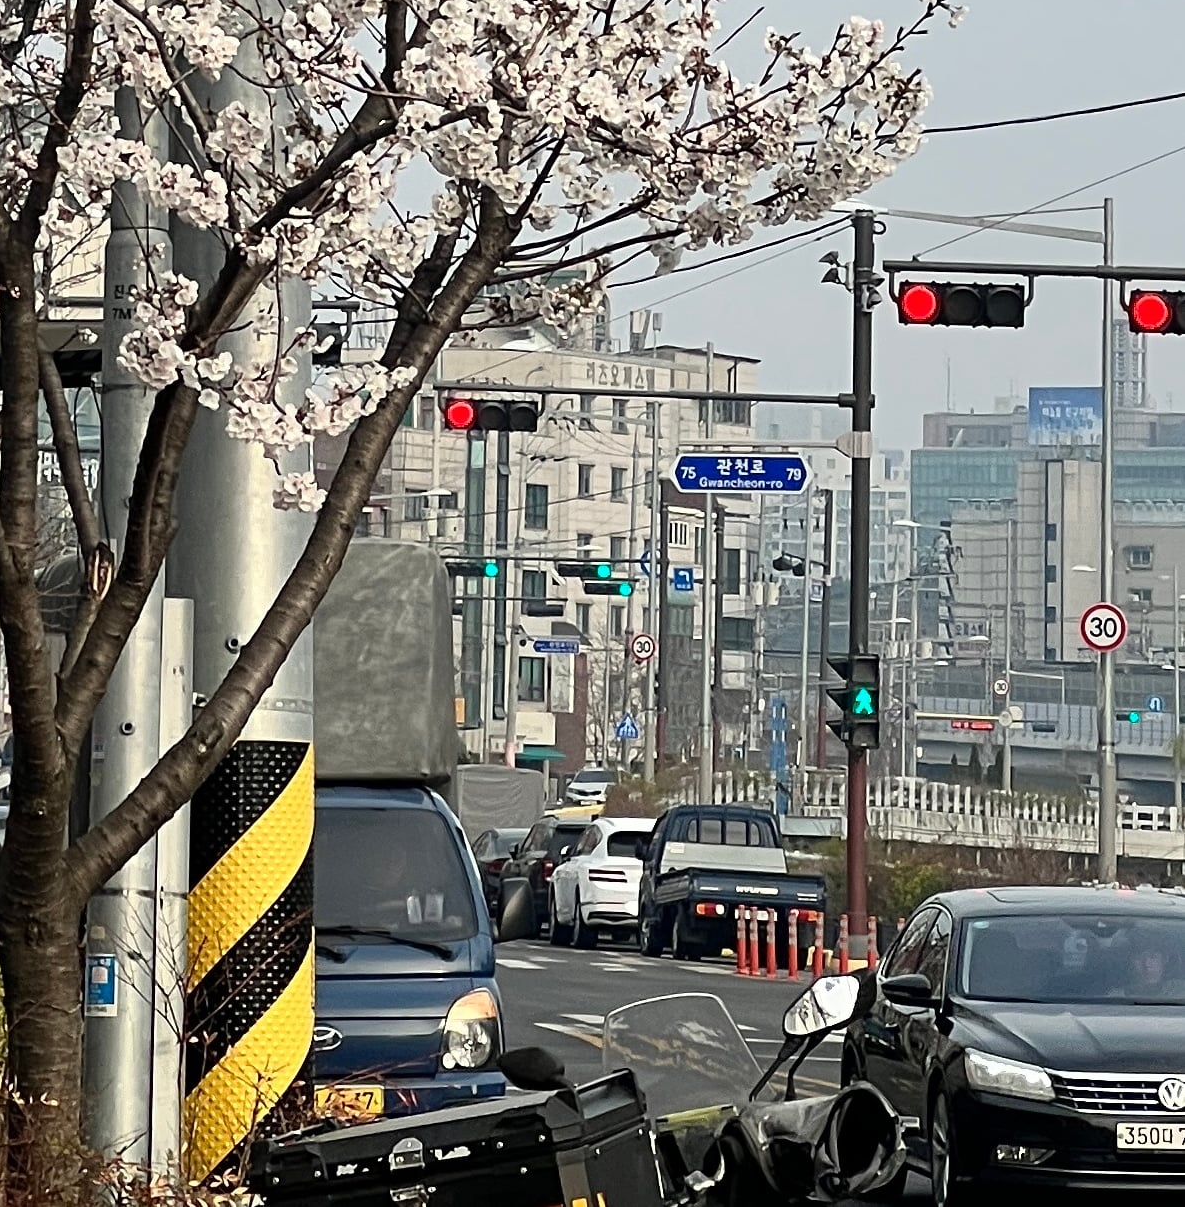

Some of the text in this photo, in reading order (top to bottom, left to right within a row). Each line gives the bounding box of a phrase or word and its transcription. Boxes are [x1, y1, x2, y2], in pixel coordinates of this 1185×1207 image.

[680, 467, 696, 479] 75
[716, 458, 766, 475] 관천로
[786, 468, 802, 481] 79
[699, 476, 783, 489] Gwancheon-ro
[1089, 617, 1118, 638] 30
[635, 640, 651, 654] 30
[995, 682, 1007, 692] 30
